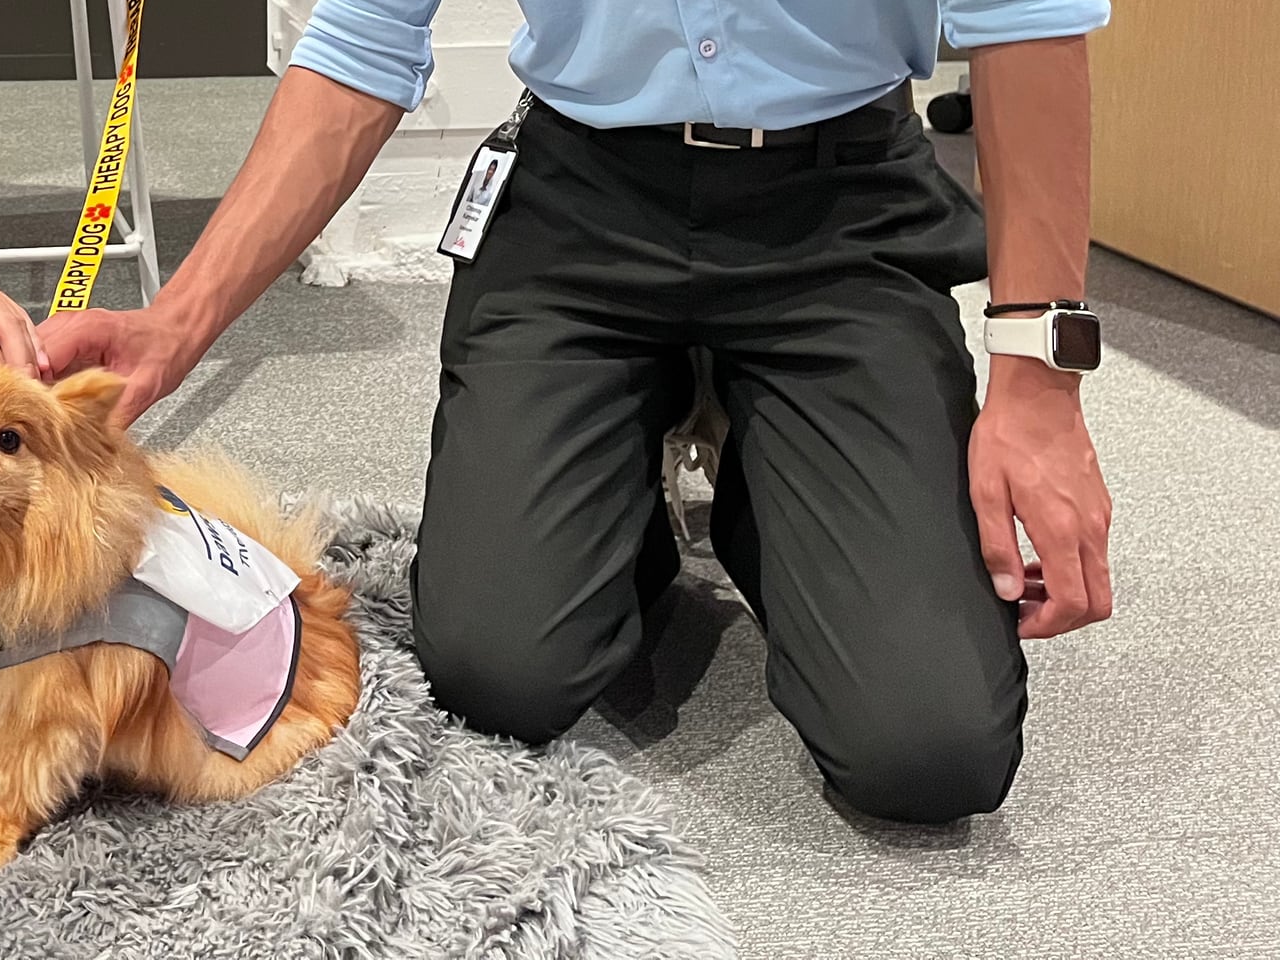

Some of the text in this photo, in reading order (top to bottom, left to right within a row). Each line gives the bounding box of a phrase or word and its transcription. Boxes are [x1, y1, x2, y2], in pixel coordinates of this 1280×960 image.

[92, 82, 131, 194] THERAPY DOG
[56, 224, 106, 312] ERAPY DOG
